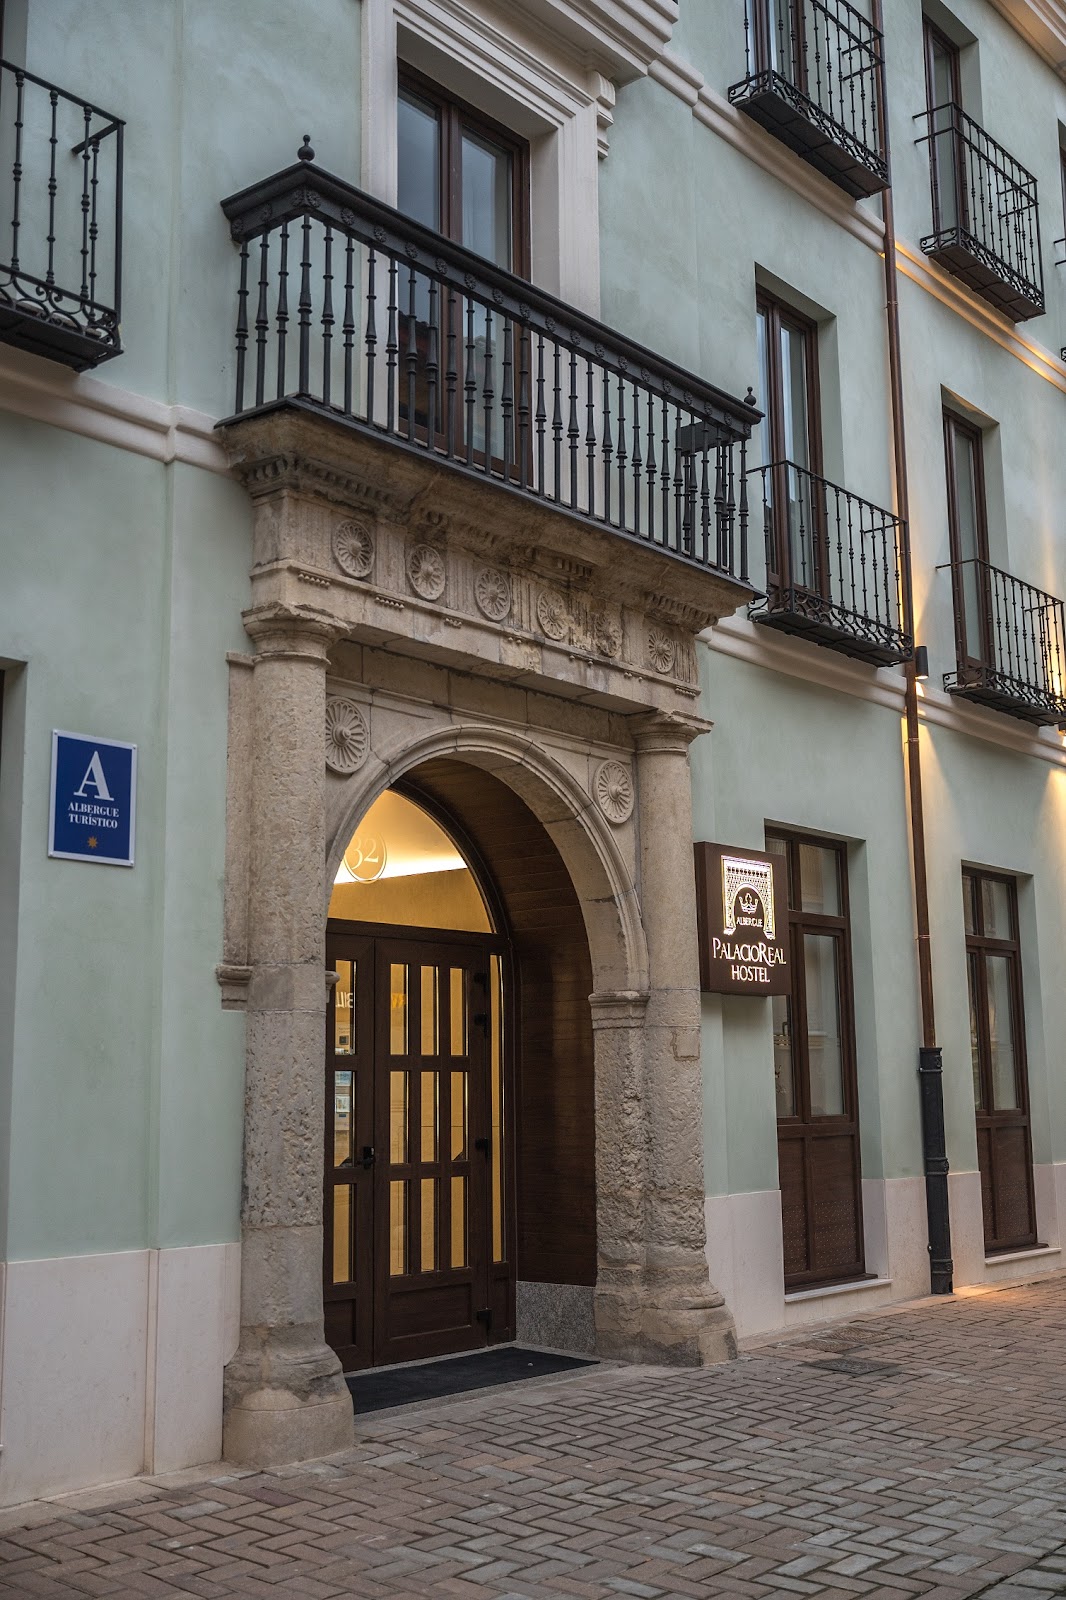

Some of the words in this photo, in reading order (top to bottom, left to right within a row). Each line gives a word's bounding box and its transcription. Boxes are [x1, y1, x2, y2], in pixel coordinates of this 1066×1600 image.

[73, 750, 115, 802] A
[67, 802, 120, 818] ALBERGUE
[68, 813, 119, 829] TURÍSTICO
[351, 837, 380, 870] 32
[736, 916, 764, 928] ALBERGUE
[731, 964, 771, 983] HOSTEL
